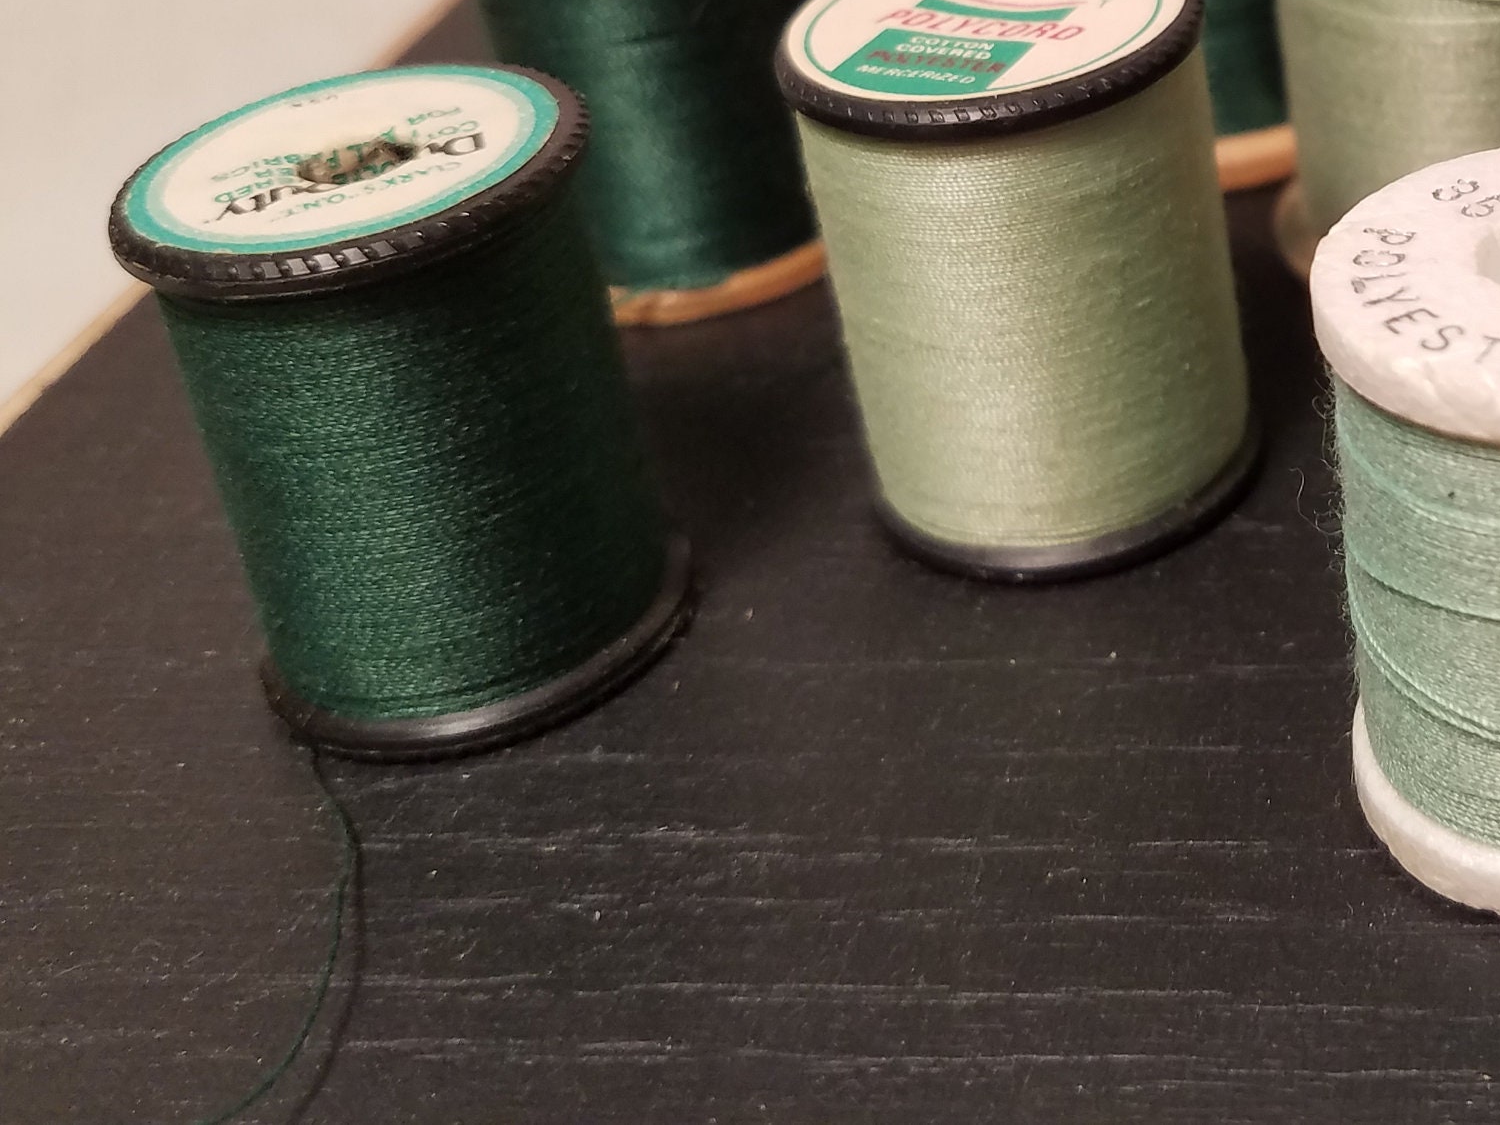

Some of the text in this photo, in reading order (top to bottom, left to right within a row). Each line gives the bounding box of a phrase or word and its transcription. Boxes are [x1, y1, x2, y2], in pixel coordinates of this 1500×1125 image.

[875, 8, 1088, 42] POLYCORD
[894, 43, 993, 62] COVERED
[910, 35, 996, 52] COTTON
[855, 63, 977, 85] MERCERIZED
